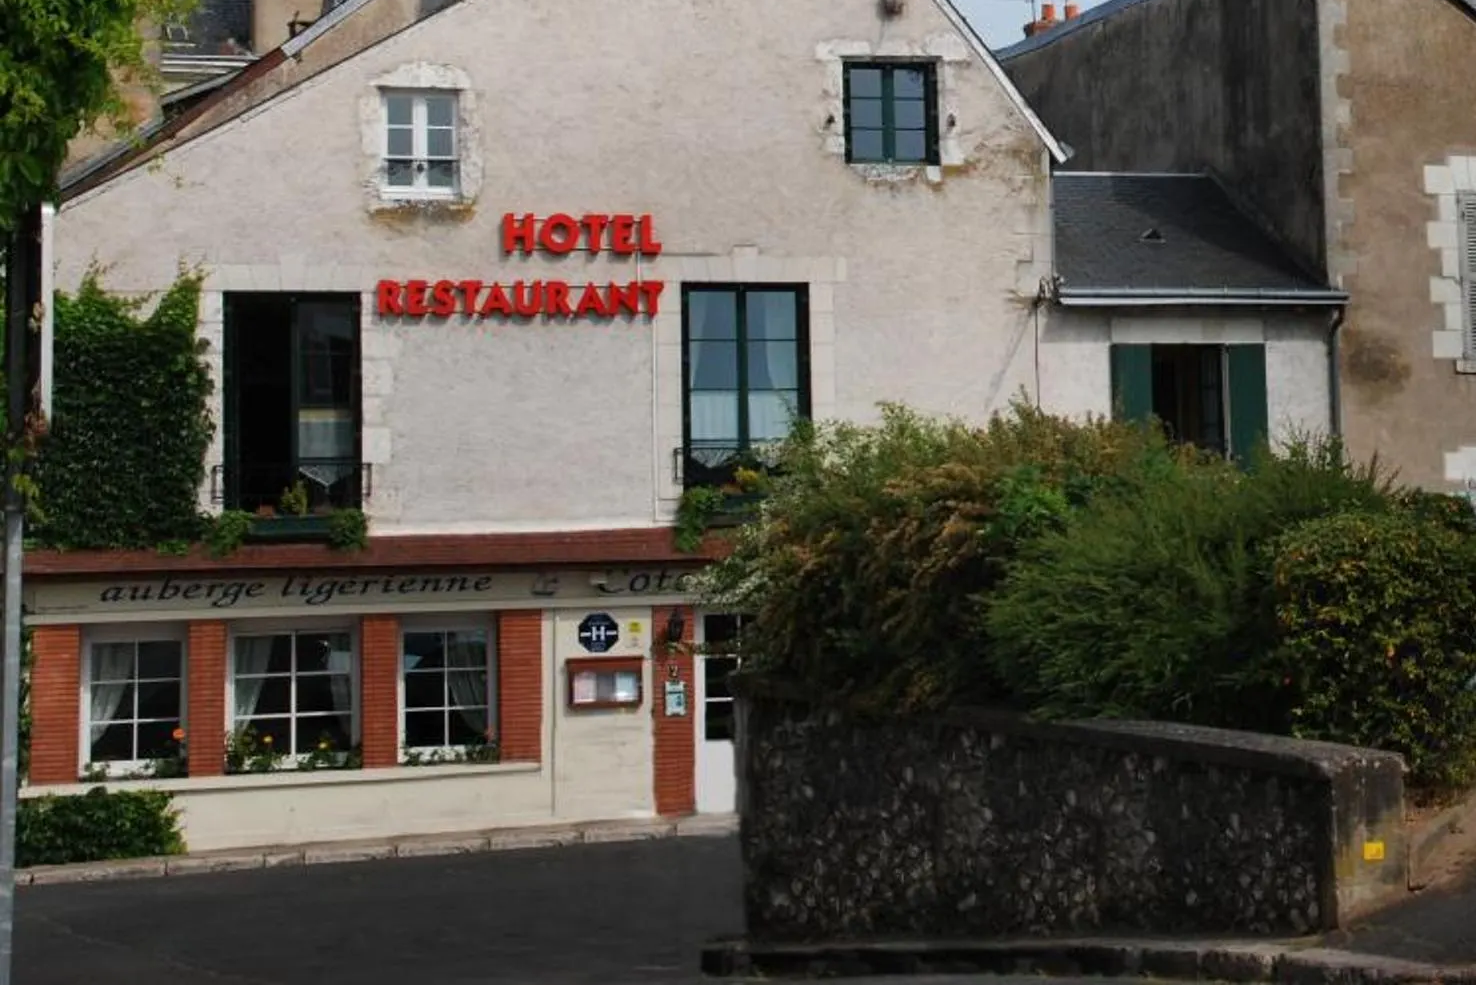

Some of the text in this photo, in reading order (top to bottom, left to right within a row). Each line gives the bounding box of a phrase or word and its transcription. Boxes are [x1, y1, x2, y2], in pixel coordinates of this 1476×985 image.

[502, 213, 662, 256] HOTEL
[376, 280, 664, 319] RESTAURANT
[100, 575, 266, 607] auberge
